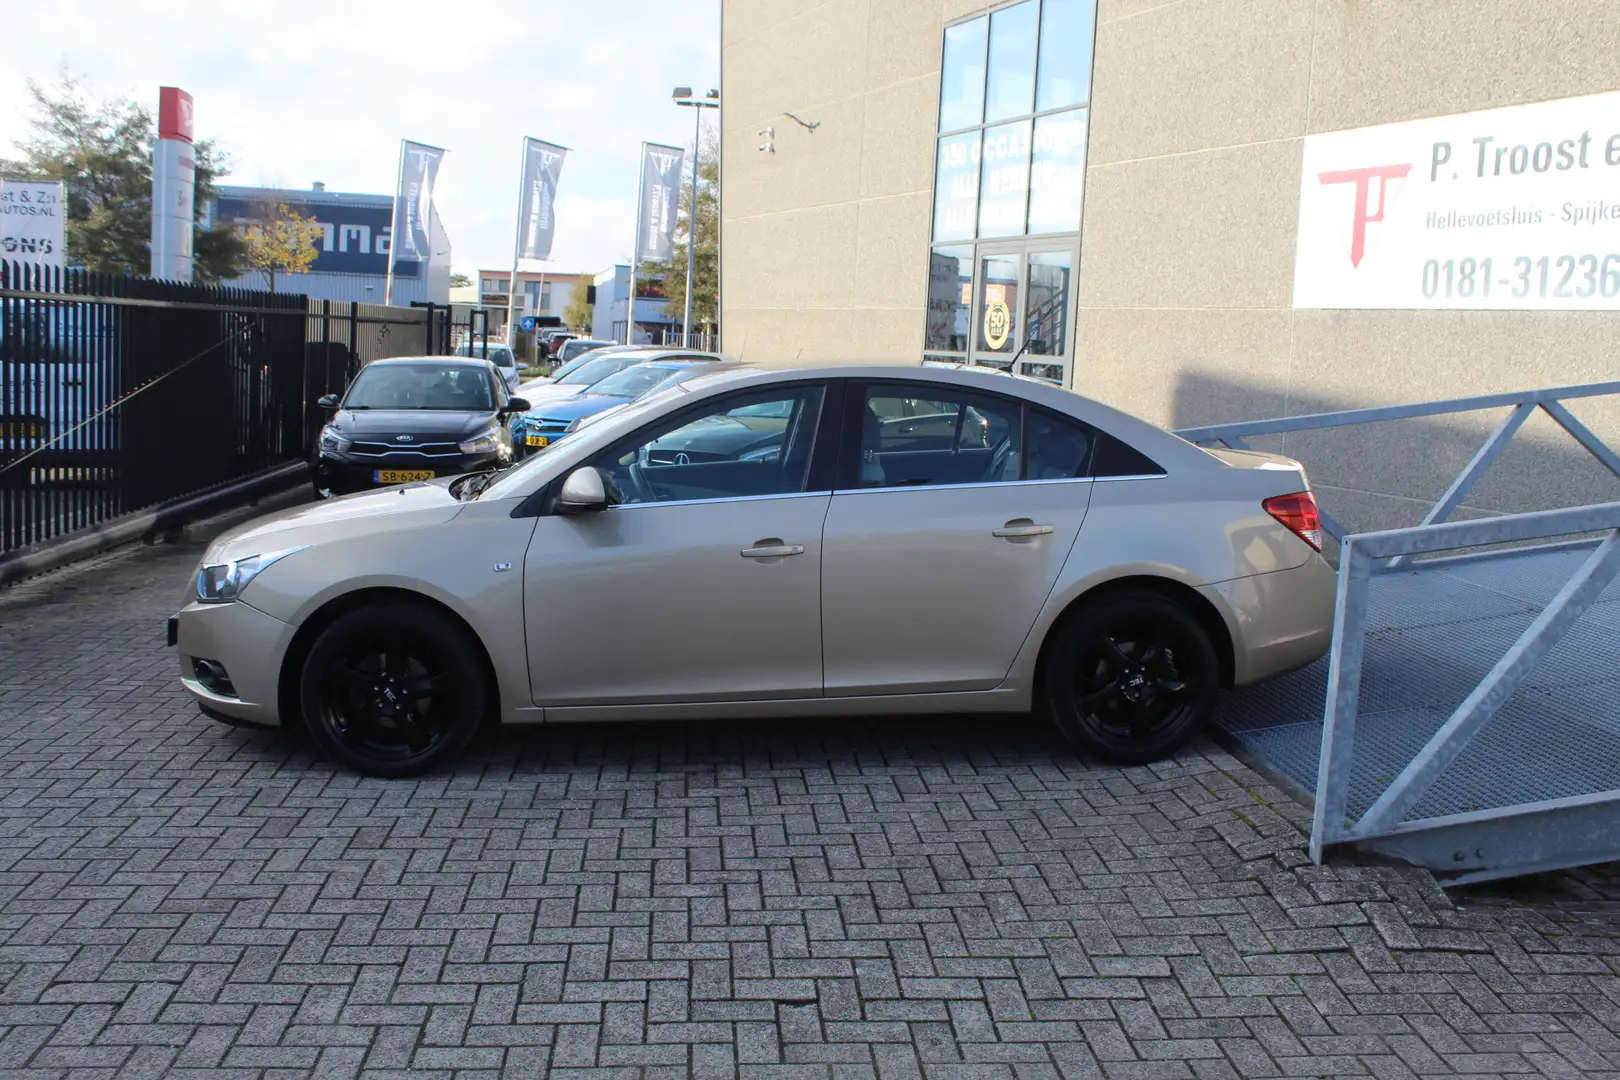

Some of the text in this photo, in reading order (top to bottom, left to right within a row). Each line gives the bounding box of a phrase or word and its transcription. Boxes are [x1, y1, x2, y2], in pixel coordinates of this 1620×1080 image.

[970, 121, 1083, 164] OCCASIO
[1430, 141, 1459, 182] P.
[1472, 130, 1592, 178] Troost
[20, 190, 32, 203] &
[1426, 204, 1542, 230] Hellevoetsluis
[1421, 252, 1620, 300] 0181-31236
[990, 311, 1004, 328] 50
